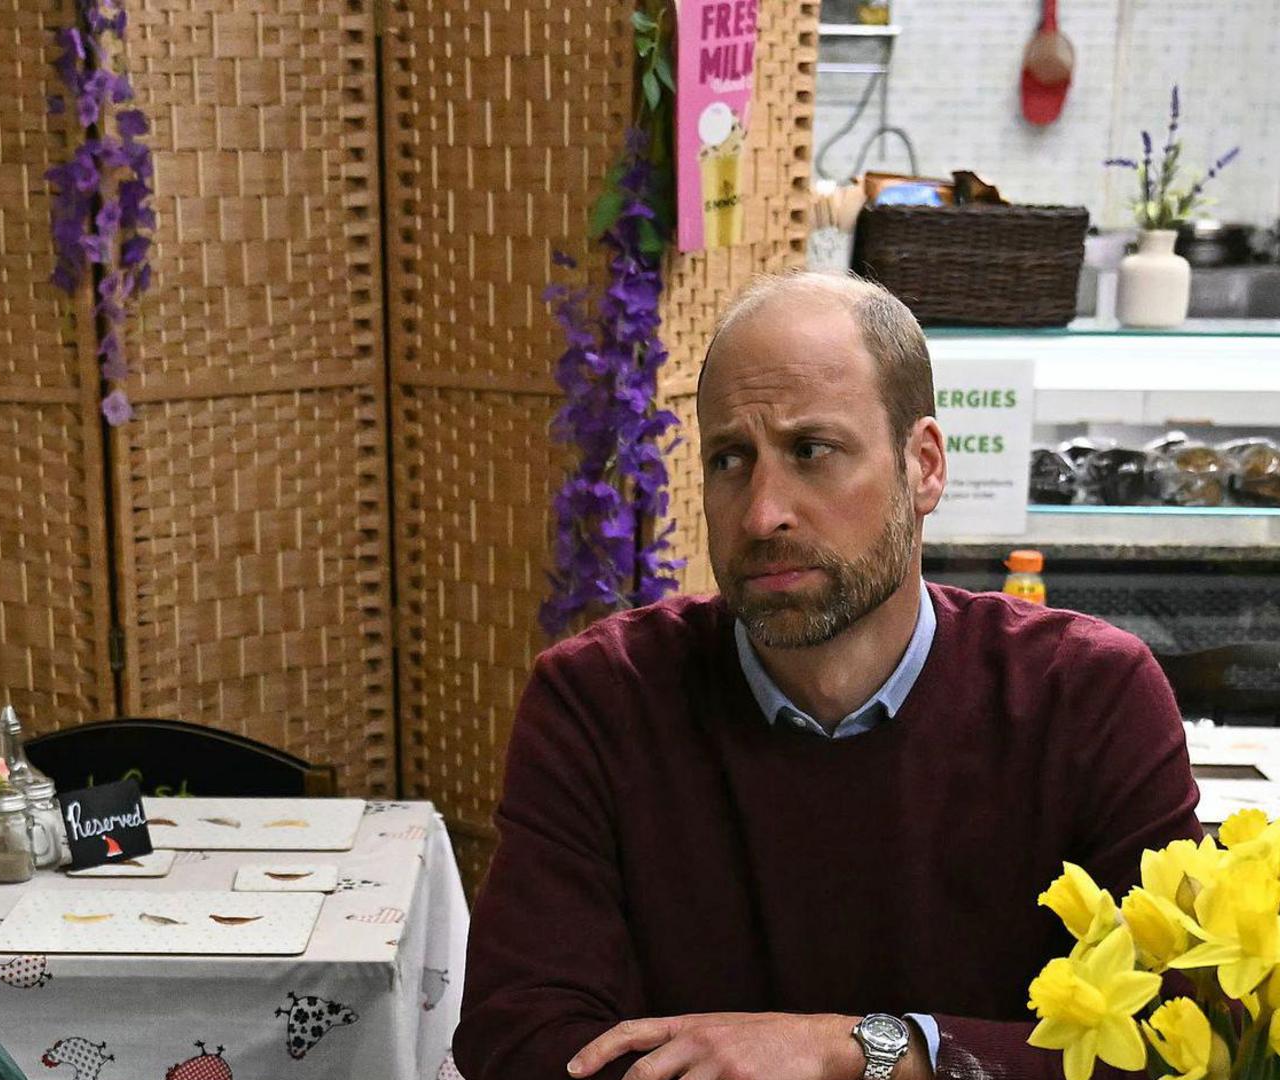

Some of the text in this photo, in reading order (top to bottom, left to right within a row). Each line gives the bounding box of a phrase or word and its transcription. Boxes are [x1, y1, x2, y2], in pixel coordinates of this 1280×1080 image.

[936, 390, 1017, 409] ERGIES
[946, 435, 1005, 454] NCES
[67, 801, 147, 841] Reserved
